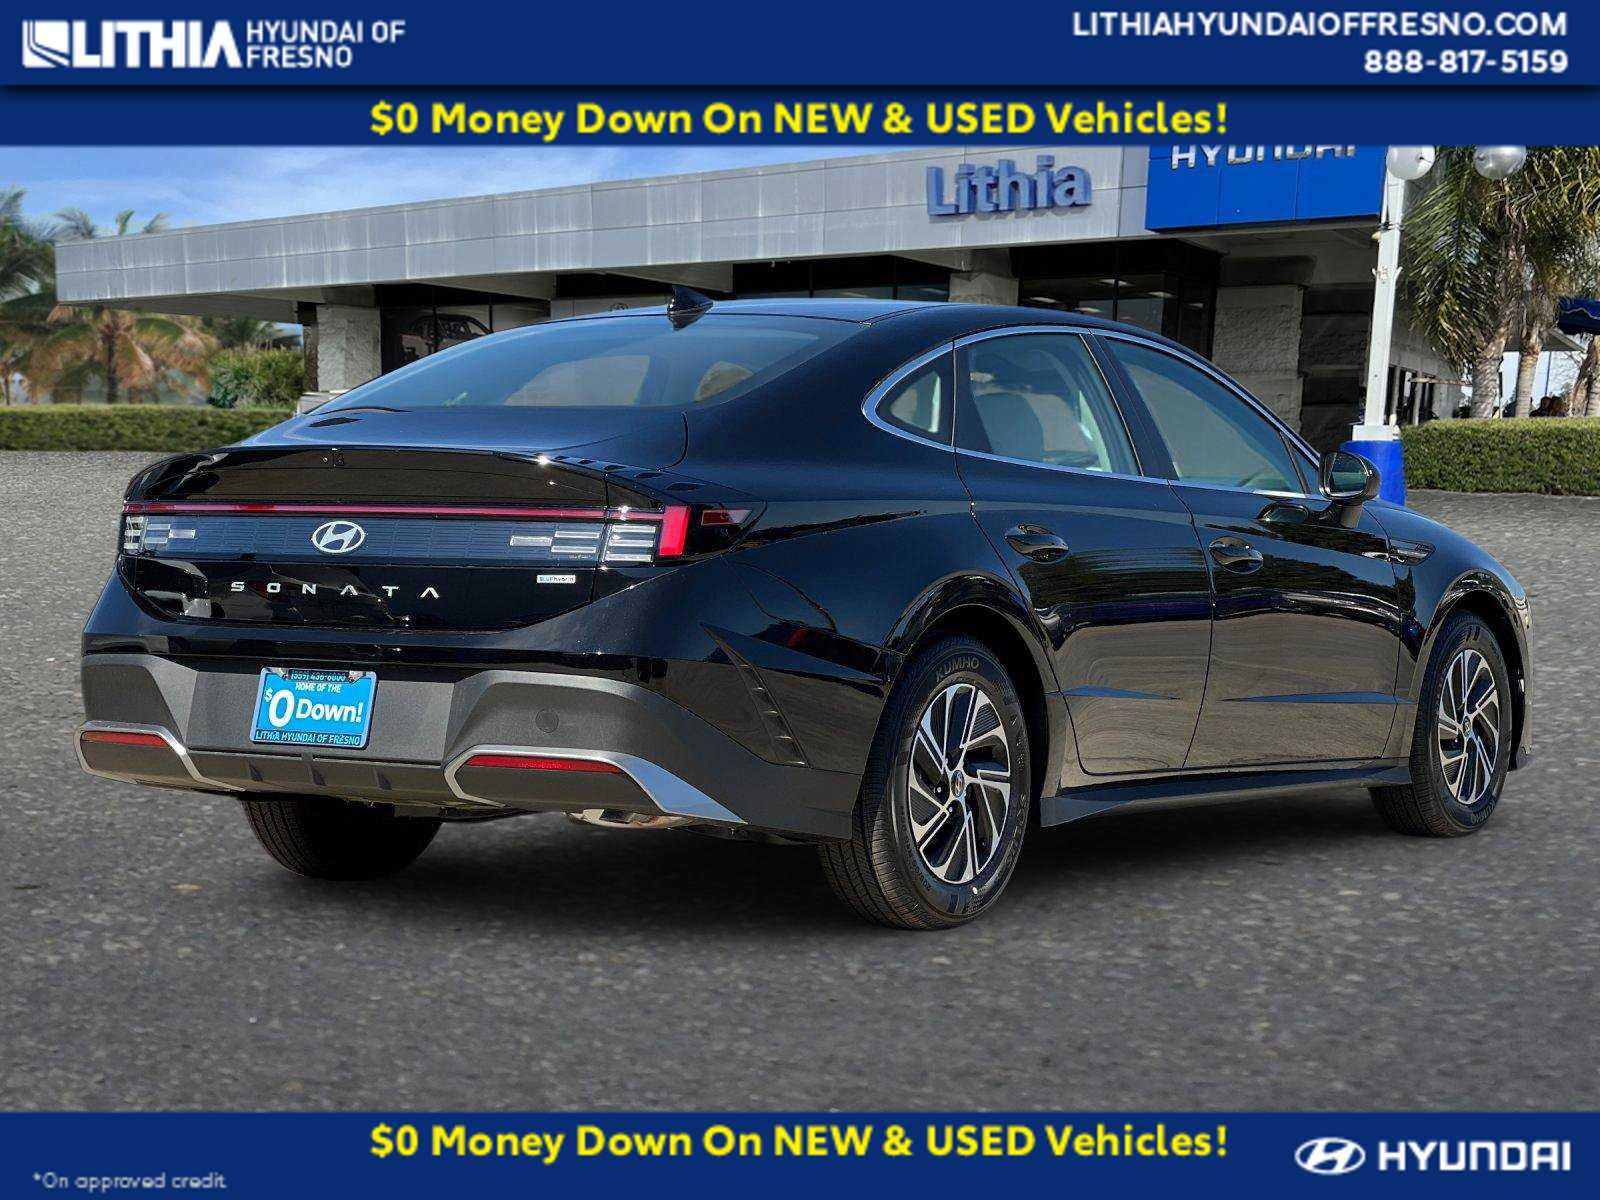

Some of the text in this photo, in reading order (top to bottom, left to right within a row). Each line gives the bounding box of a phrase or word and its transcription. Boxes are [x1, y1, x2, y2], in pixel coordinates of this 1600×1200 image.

[926, 154, 1092, 216] Lithia
[230, 582, 439, 599] SONATA
[935, 655, 981, 682] KUMHO
[295, 682, 341, 694] HOME OF THE
[295, 698, 363, 723] Down!
[254, 731, 360, 746] LITHIA HYUNDAI OF FRESNO
